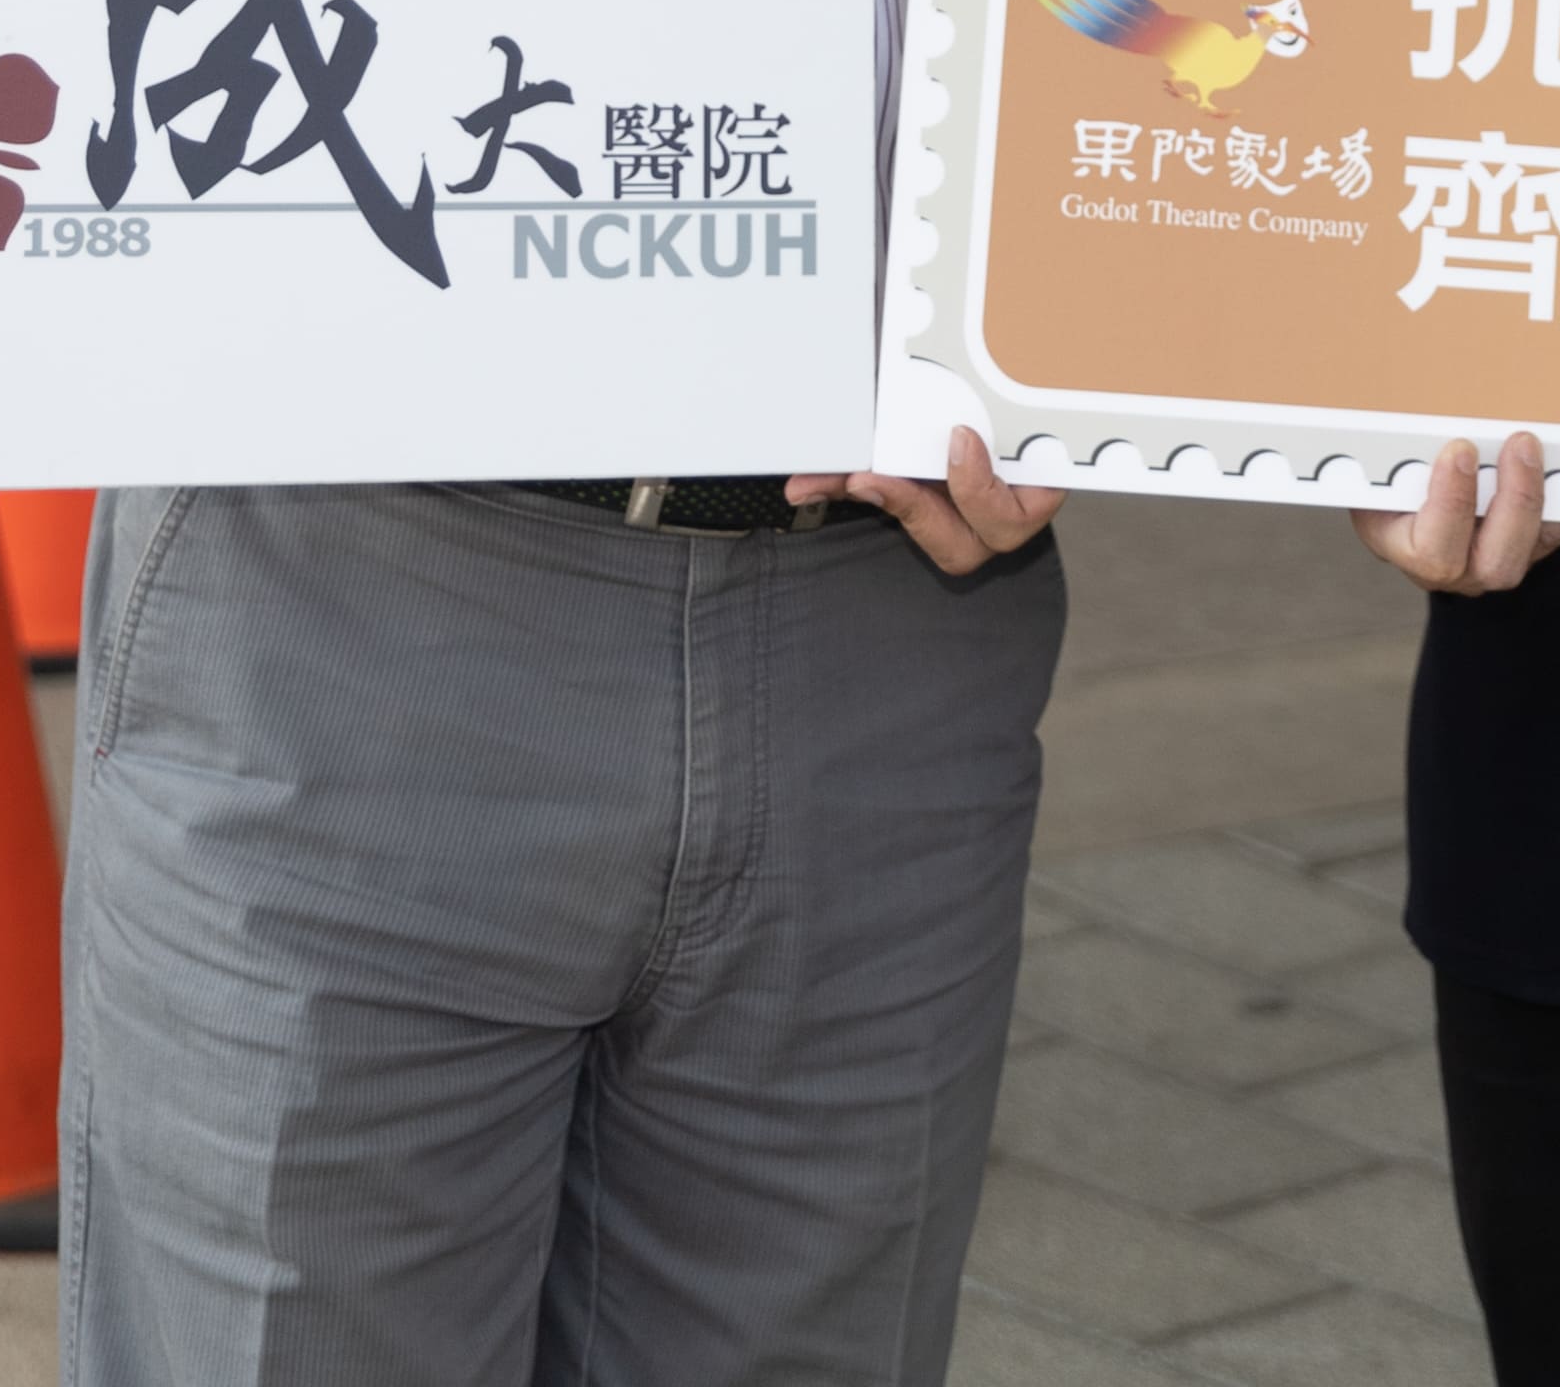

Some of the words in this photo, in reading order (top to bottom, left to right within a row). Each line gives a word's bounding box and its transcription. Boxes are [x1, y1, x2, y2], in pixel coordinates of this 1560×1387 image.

[21, 217, 151, 260] 1988
[1060, 193, 1140, 223] Godot
[1146, 198, 1242, 231] Theatre
[1248, 207, 1369, 246] Company
[513, 214, 818, 281] NCKUH
